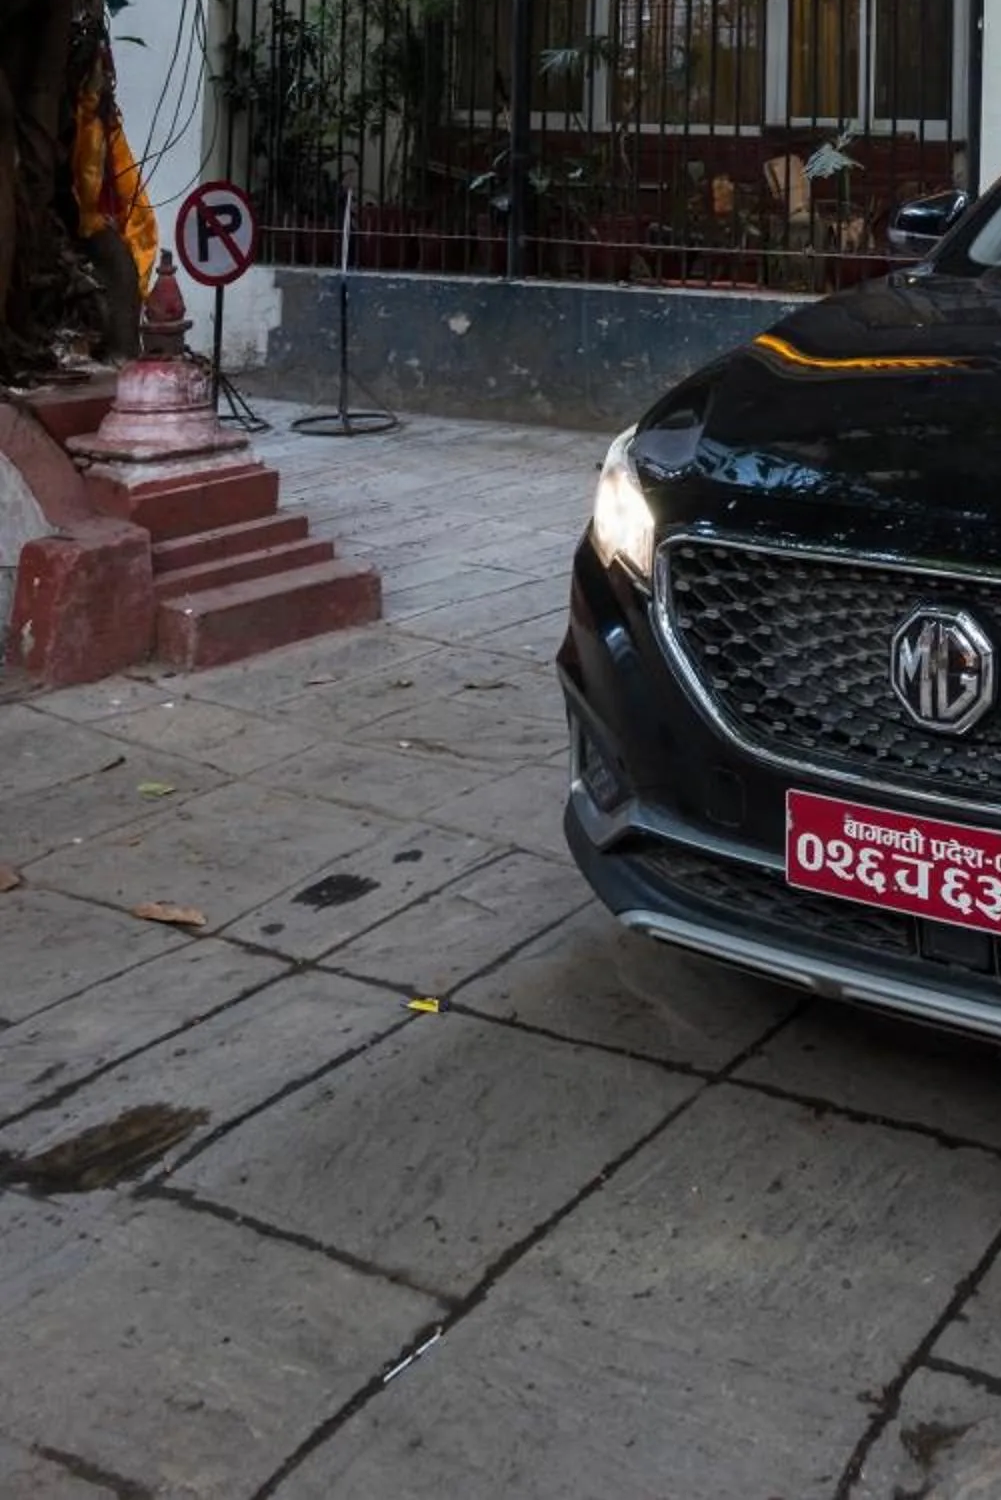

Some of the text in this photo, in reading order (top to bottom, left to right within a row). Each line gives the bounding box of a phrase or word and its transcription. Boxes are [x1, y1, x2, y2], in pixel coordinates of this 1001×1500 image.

[196, 203, 242, 263] P
[899, 619, 978, 719] MG
[842, 814, 925, 855] बागमती
